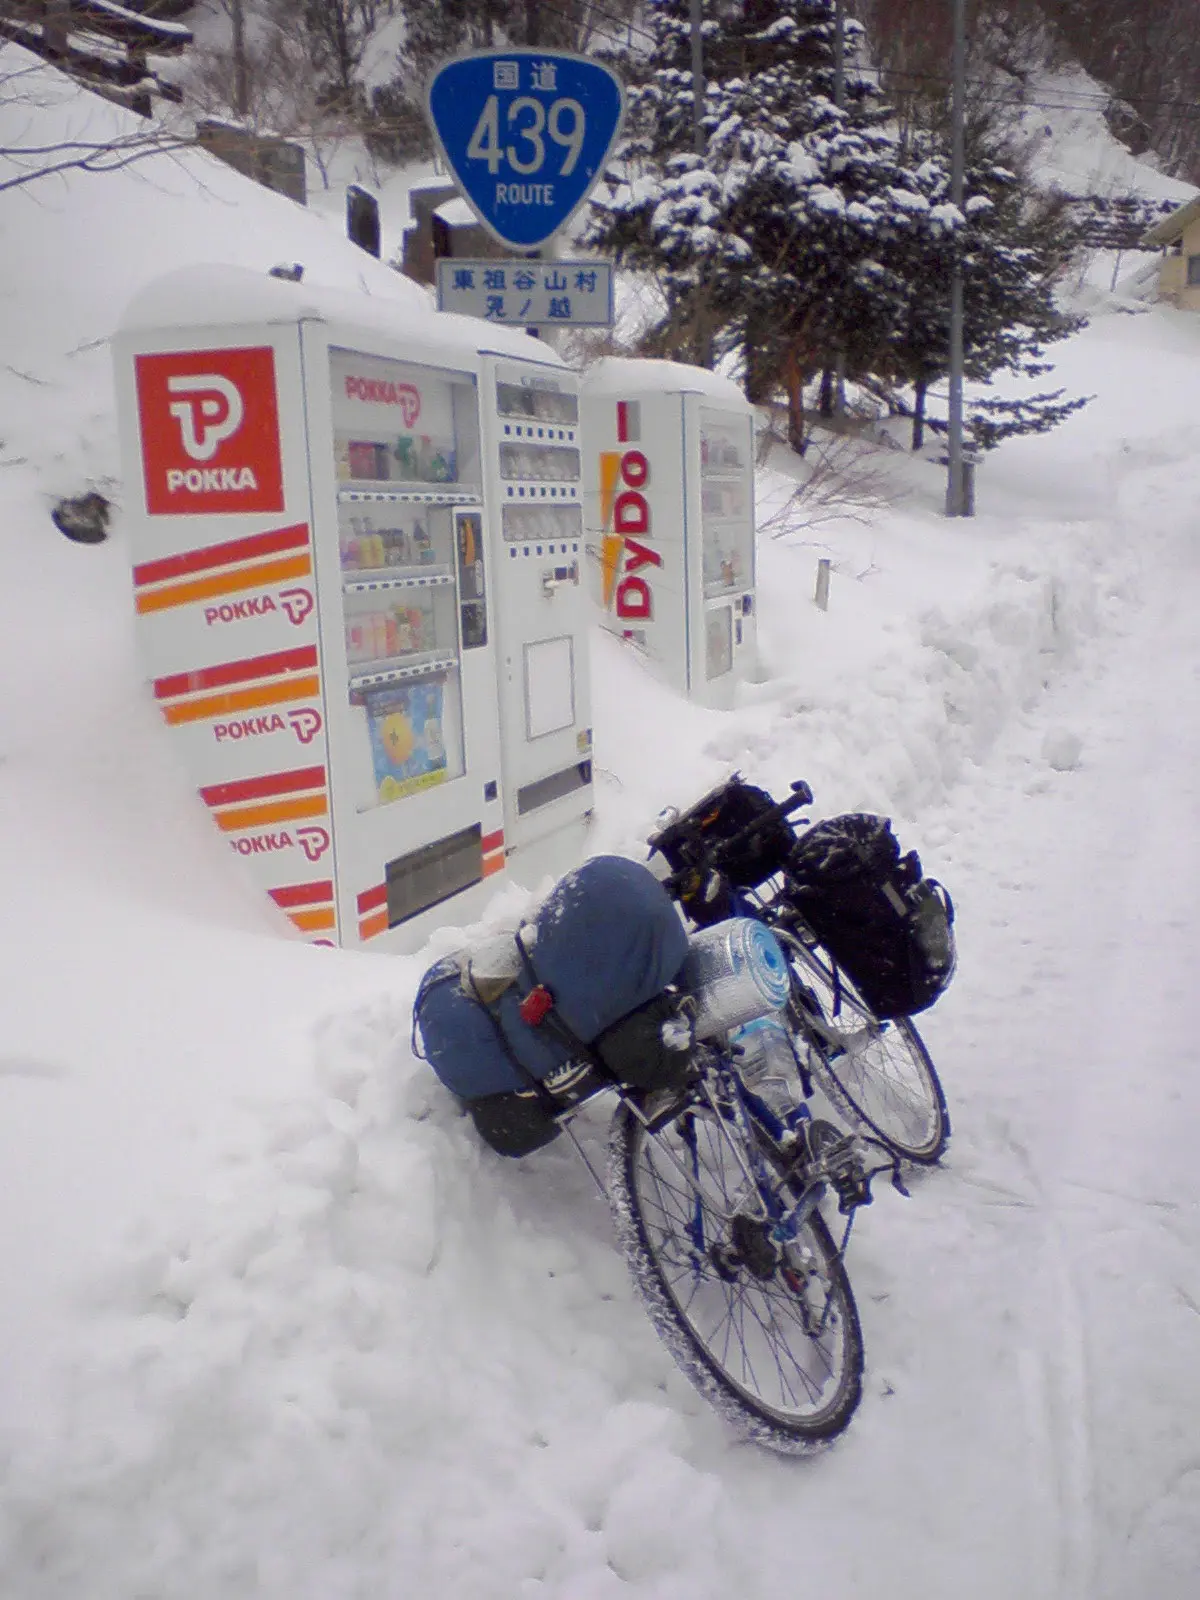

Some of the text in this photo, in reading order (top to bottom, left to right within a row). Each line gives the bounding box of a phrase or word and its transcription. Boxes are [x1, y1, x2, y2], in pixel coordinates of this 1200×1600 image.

[493, 61, 558, 90] 国道
[466, 95, 586, 176] 439
[495, 184, 555, 206] ROUTE
[452, 269, 598, 293] 東祖谷山村
[344, 376, 398, 403] POKKA
[167, 468, 257, 493] POKKA
[614, 450, 662, 617] DyDo
[204, 594, 277, 626] POKKA
[213, 713, 286, 742] POKKA
